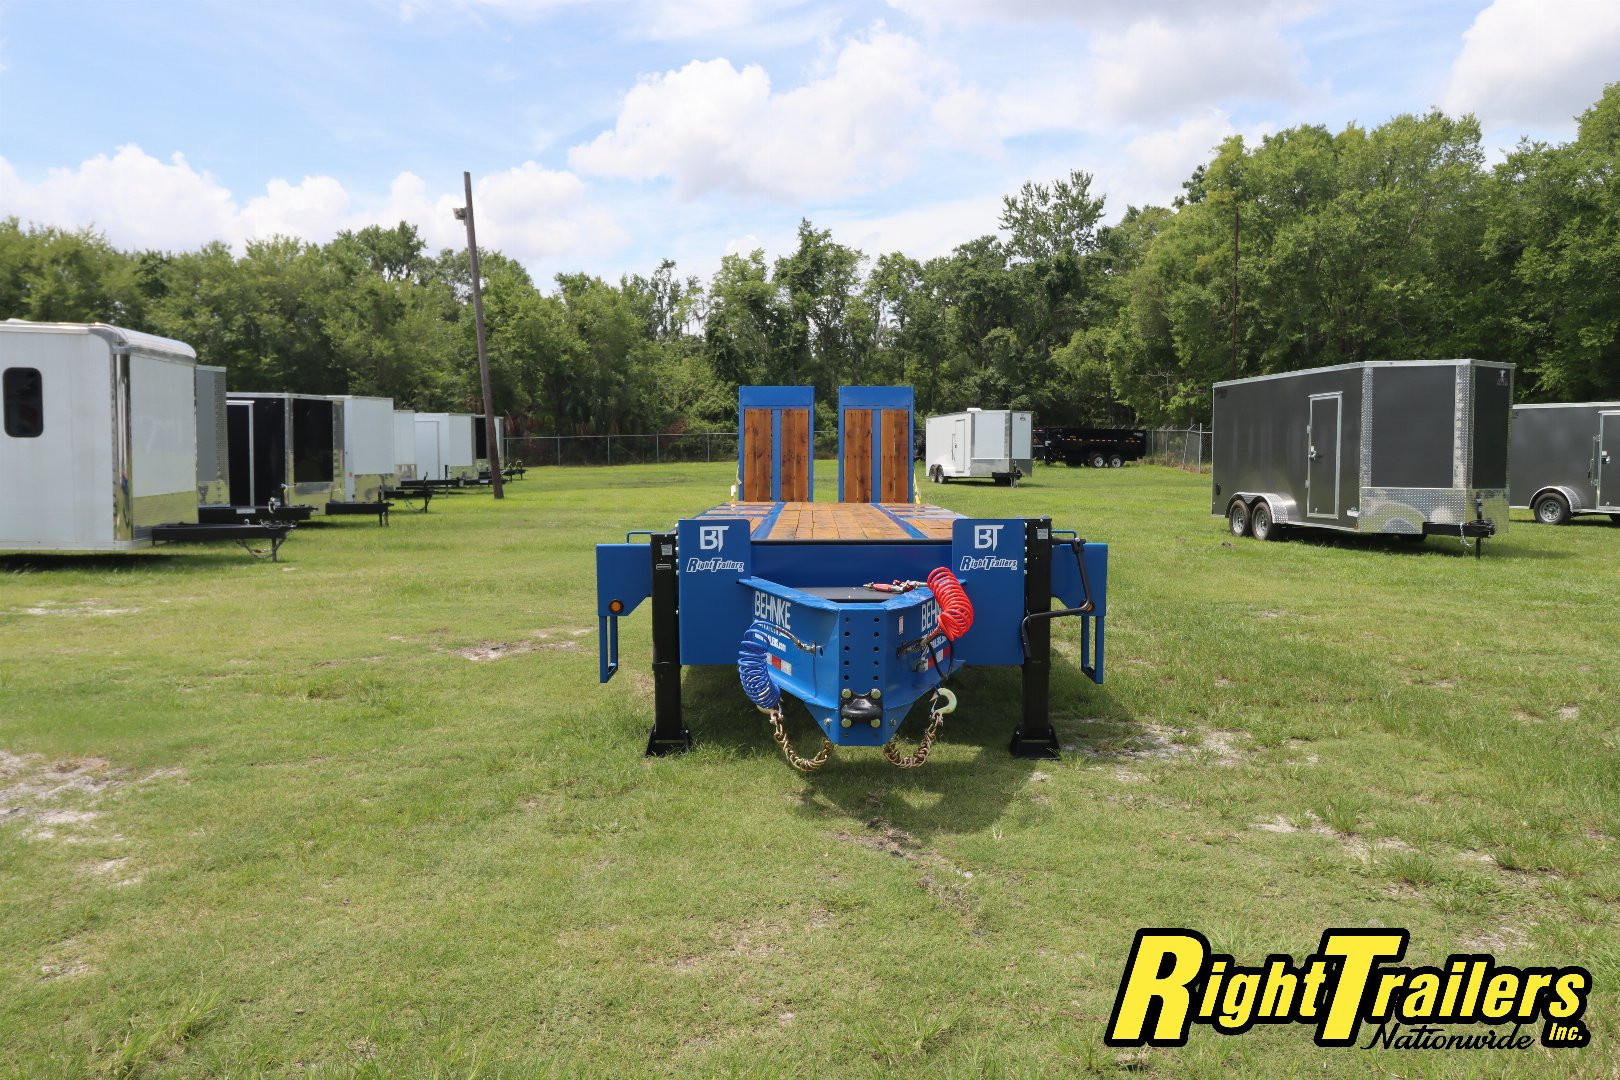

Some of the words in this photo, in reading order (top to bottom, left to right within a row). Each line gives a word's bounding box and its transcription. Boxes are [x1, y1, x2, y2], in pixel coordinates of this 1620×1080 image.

[699, 525, 730, 552] BT
[974, 524, 1005, 551] BT
[754, 590, 792, 630] BEHNKE
